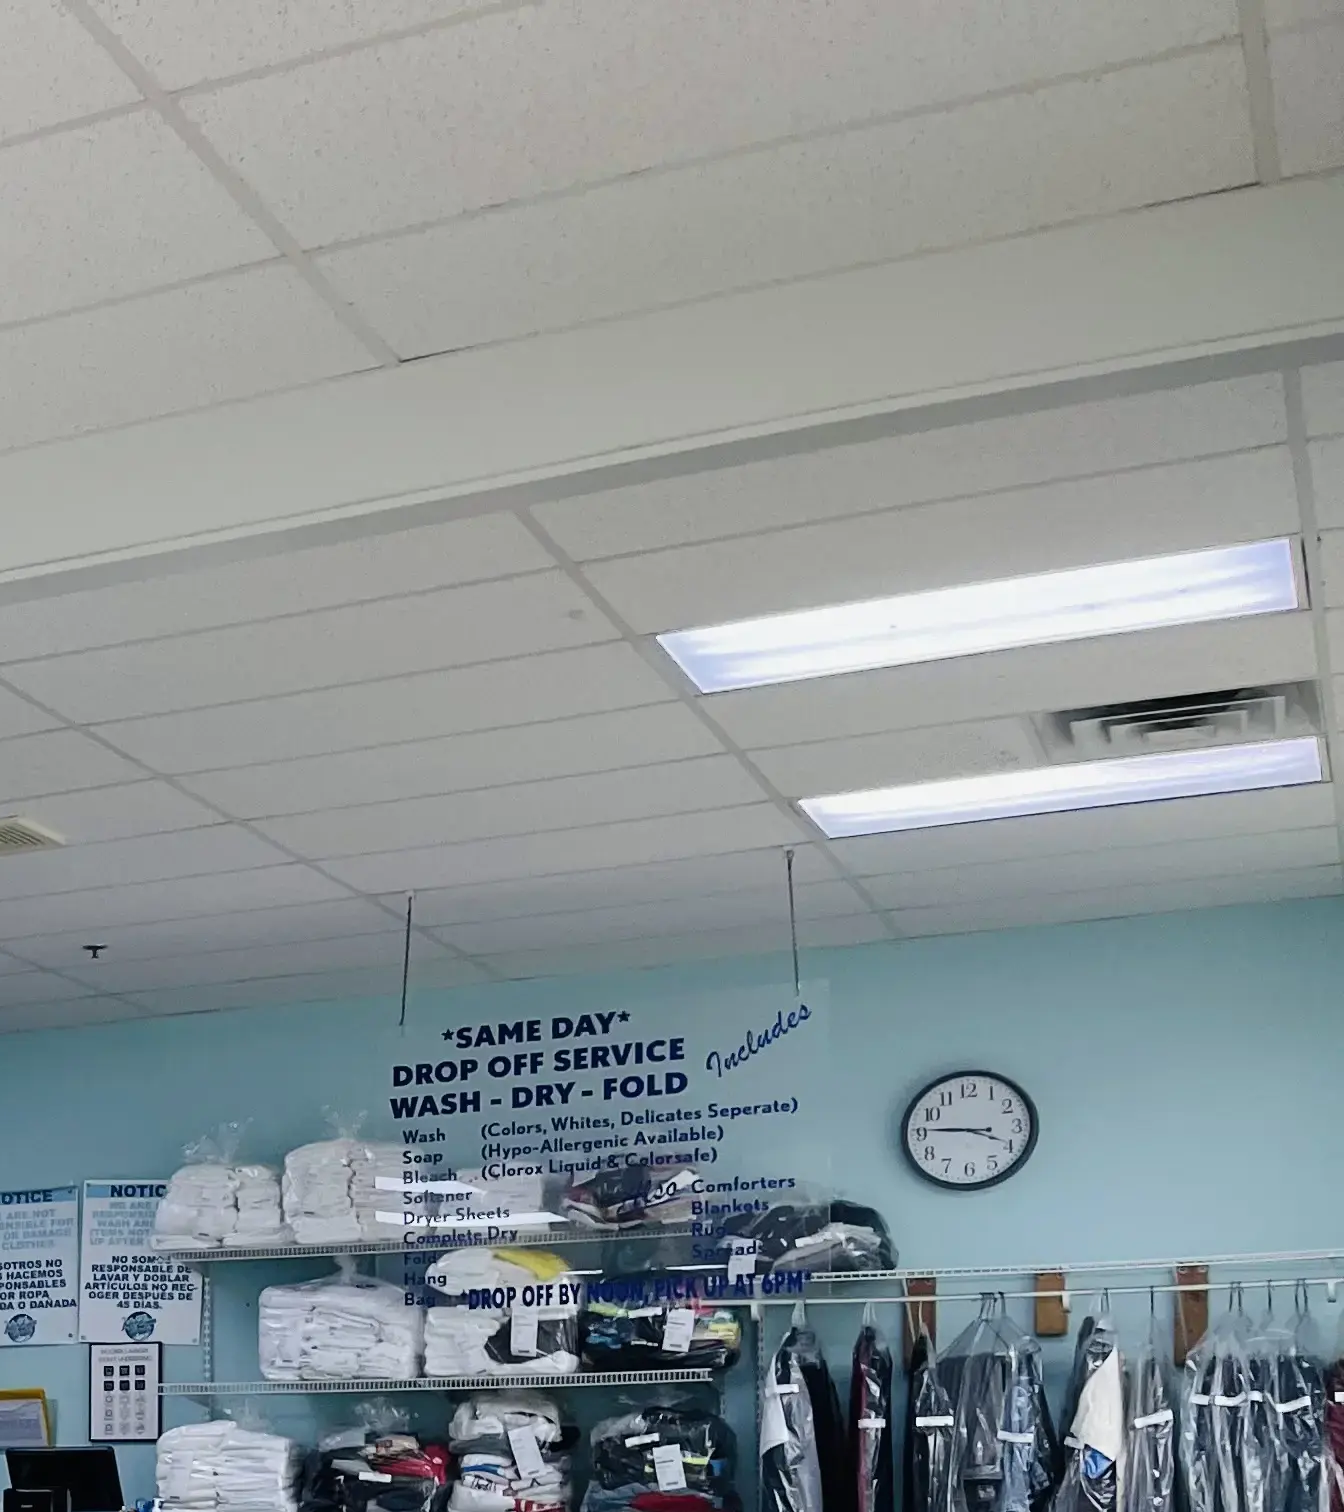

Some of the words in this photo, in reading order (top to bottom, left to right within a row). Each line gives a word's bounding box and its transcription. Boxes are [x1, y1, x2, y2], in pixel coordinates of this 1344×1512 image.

[705, 1003, 812, 1078] Includes
[392, 1059, 479, 1087] DROP
[487, 1052, 544, 1078] OFF
[553, 1038, 685, 1072] SERVICE
[389, 1090, 481, 1119] WASH
[511, 1081, 576, 1109] DRY
[603, 1072, 688, 1101] FOLD
[960, 1082, 978, 1099] 12
[988, 1085, 994, 1101] 1
[939, 1091, 953, 1107] 11
[1001, 1098, 1013, 1115] 2
[402, 1127, 446, 1144] Wash
[481, 1121, 547, 1140] (Colors,
[551, 1115, 615, 1131] Whites,
[620, 1108, 702, 1126] Delicates
[707, 1097, 799, 1120] Seperate)
[924, 1106, 941, 1122] 10
[915, 1126, 928, 1142] 9
[1011, 1118, 1023, 1134] 3
[402, 1150, 444, 1165] Soap
[481, 1135, 629, 1161] (Hypo-Allergenic
[633, 1125, 724, 1146] Available)
[924, 1145, 935, 1161] 8
[402, 1168, 458, 1184] Bleach
[481, 1162, 544, 1180] (Clorox
[548, 1154, 602, 1177] Liquid
[624, 1147, 718, 1168] Colorsafe)
[940, 1157, 952, 1174] 7
[964, 1161, 976, 1177] 6
[986, 1154, 998, 1171] 5
[110, 1183, 168, 1198] NOTIC
[691, 1176, 796, 1194] Comforters
[403, 1190, 473, 1205] Softener
[403, 1211, 451, 1228] Dryer
[455, 1207, 511, 1222] Sheets
[403, 1230, 483, 1248] Complete
[487, 1226, 518, 1243] Dry
[45, 1258, 63, 1268] NO
[111, 1255, 128, 1264] NO
[403, 1252, 438, 1266] Fold
[6, 1269, 63, 1280] HACEMOS
[91, 1264, 174, 1274] RESPONSABLE
[92, 1273, 130, 1283] LAVAR
[132, 1274, 141, 1282] Y
[143, 1273, 191, 1283] DOBLAR
[403, 1271, 448, 1288] Hang
[18, 1289, 50, 1300] ROPA
[151, 1283, 169, 1292] NO
[521, 1283, 554, 1307] OFF
[558, 1282, 581, 1305] BY
[703, 1275, 729, 1297] UP
[734, 1274, 756, 1296] AT
[177, 1291, 194, 1301] DE
[403, 1293, 437, 1308] Bag
[17, 1300, 26, 1310] O
[116, 1300, 130, 1309] 45
